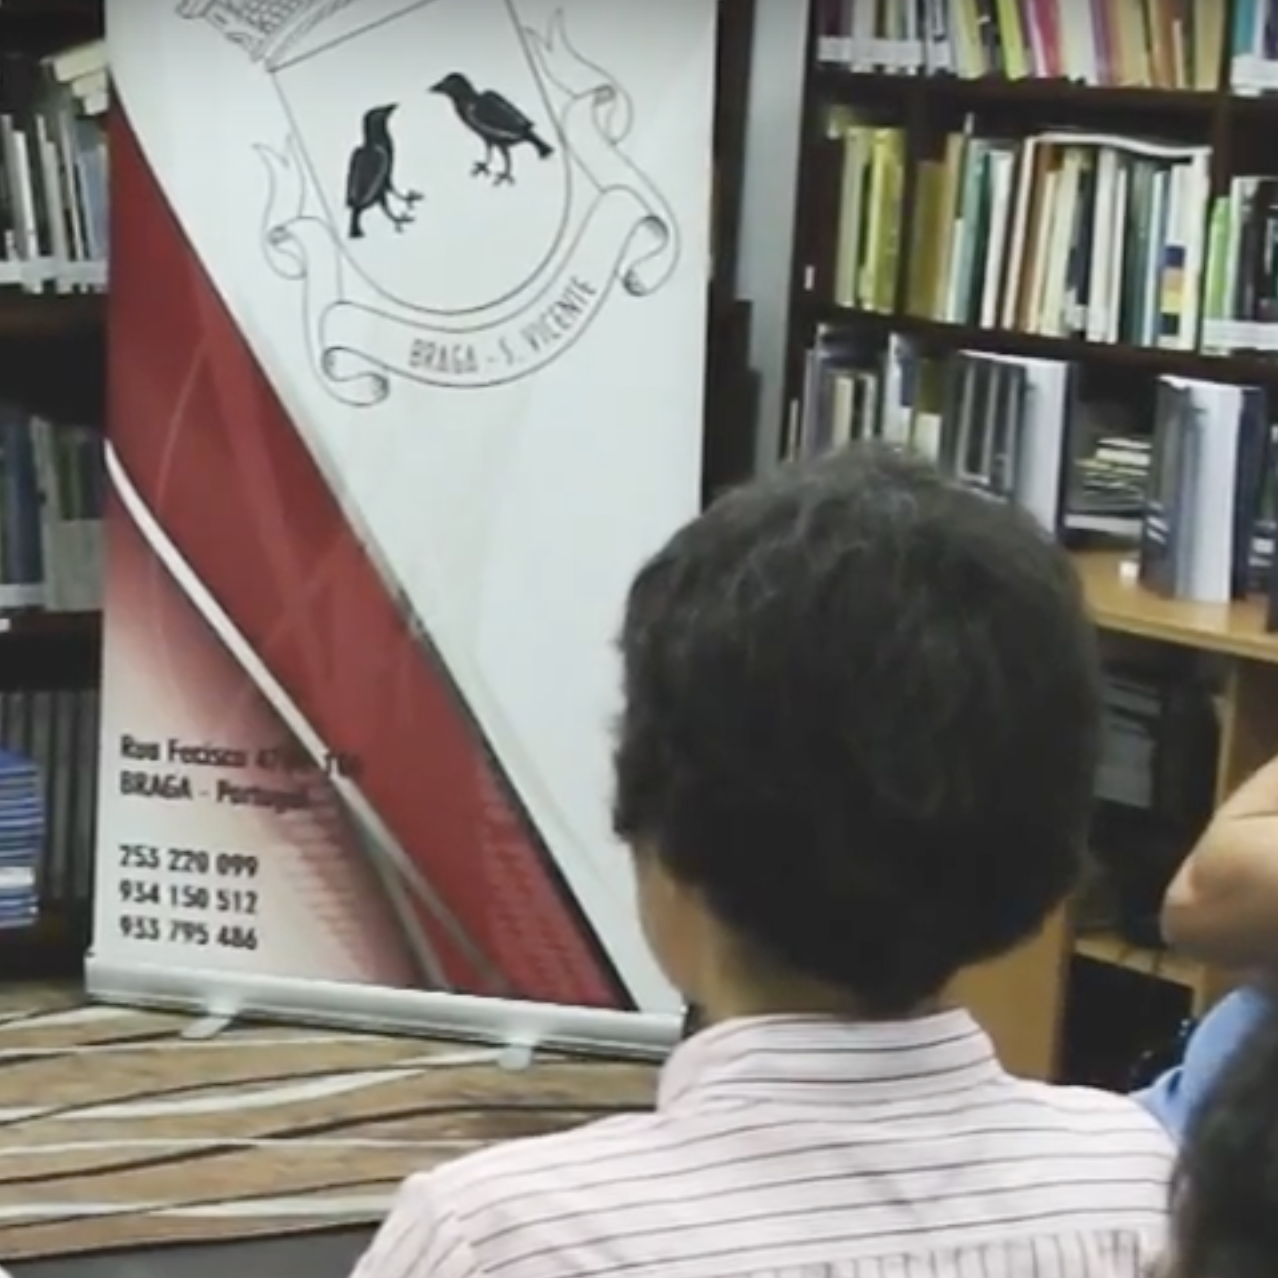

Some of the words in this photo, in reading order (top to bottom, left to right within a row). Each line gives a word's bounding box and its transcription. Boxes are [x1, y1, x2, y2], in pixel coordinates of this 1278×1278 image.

[408, 337, 478, 375] BRAGA
[520, 274, 597, 353] VICENTE
[120, 734, 160, 762] Rua
[120, 770, 193, 800] BRAGA
[119, 844, 160, 869] 253
[168, 849, 210, 874] 220
[216, 853, 258, 878] 099
[119, 879, 160, 904] 934
[169, 884, 210, 910] 150
[216, 889, 258, 915] 512
[119, 914, 160, 941] 933
[169, 919, 210, 945] 795
[216, 925, 258, 951] 486
